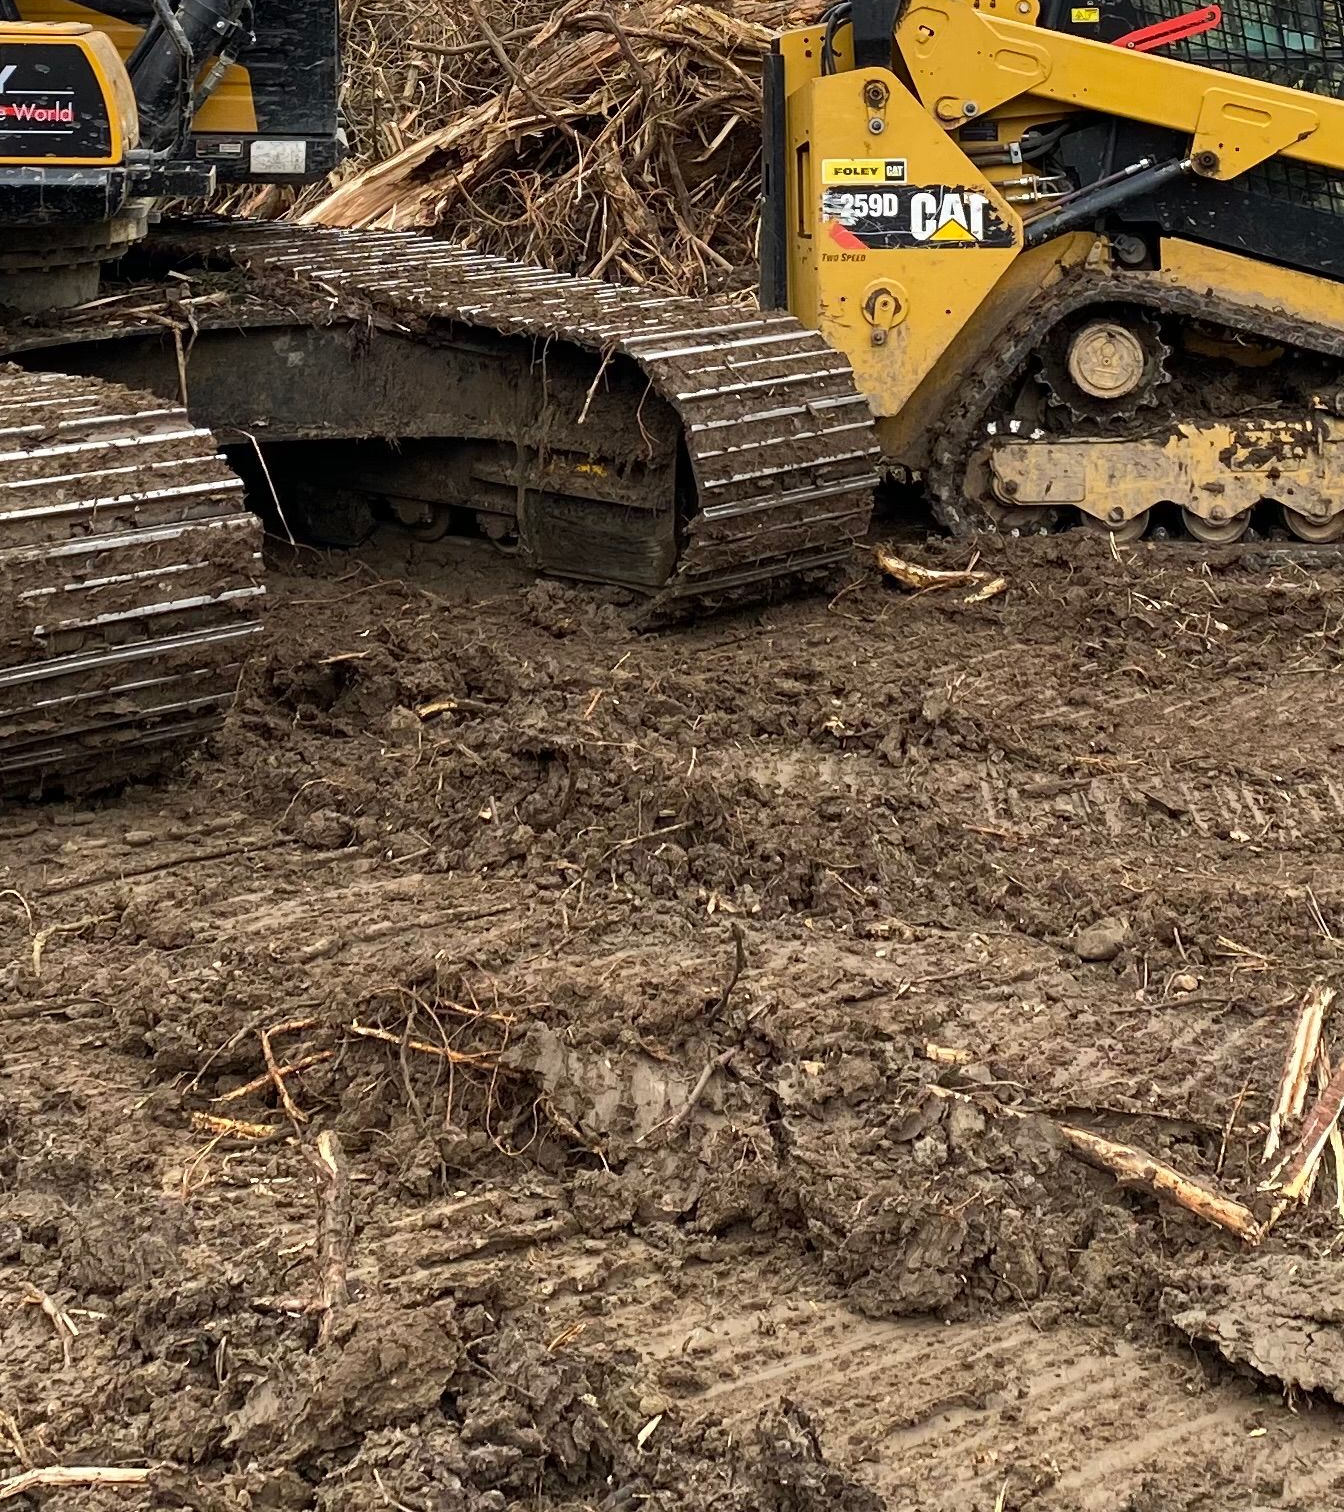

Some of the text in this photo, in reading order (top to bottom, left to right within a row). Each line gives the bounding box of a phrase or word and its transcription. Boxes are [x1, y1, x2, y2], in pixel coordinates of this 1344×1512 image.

[13, 101, 74, 122] World
[833, 165, 904, 177] FOLEY CAT
[840, 192, 990, 241] 259D CAT
